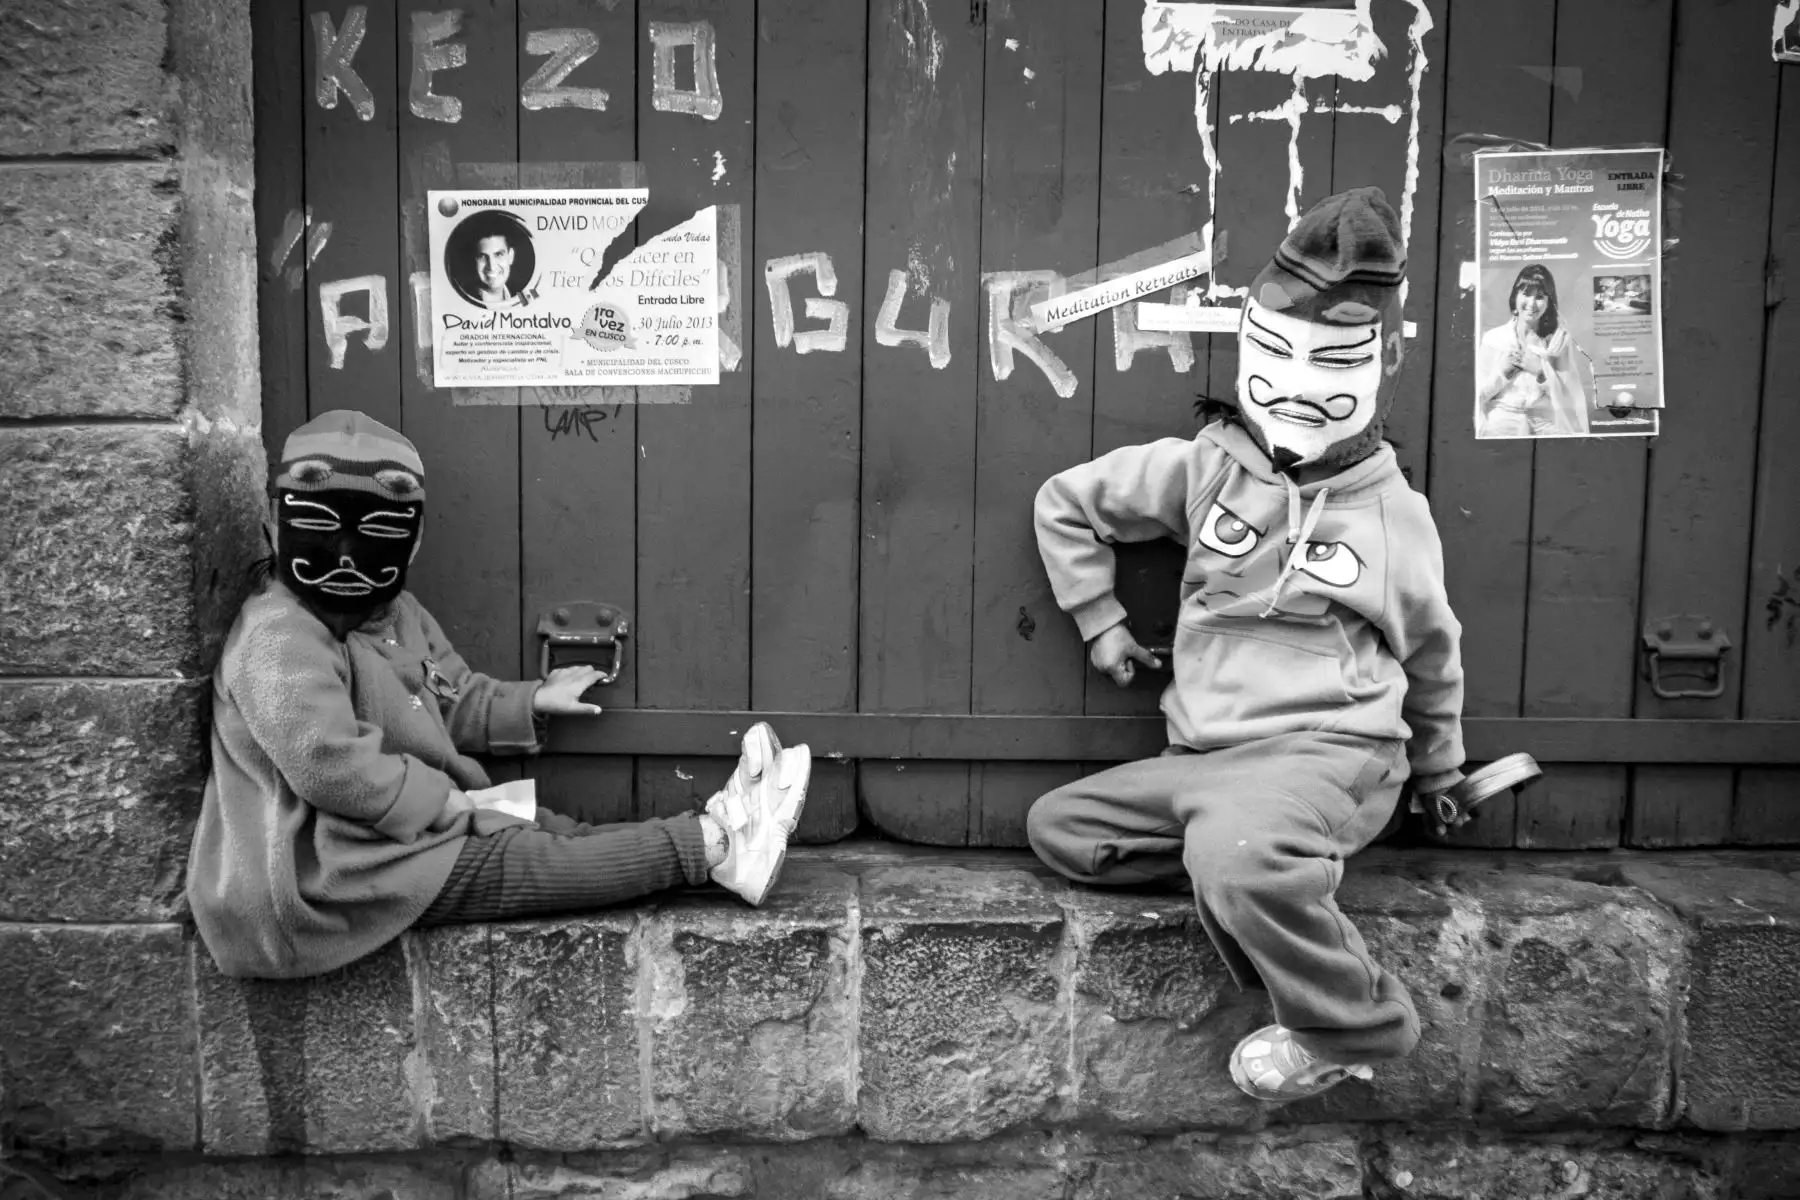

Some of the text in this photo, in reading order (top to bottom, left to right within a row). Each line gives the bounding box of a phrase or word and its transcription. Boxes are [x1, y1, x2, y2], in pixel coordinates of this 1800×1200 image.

[1556, 166, 1593, 184] Yoga
[1608, 172, 1654, 180] ENTRADA
[1488, 184, 1594, 196] Meditación y Mantras
[1617, 183, 1645, 191] LIBRE
[461, 199, 506, 207] HONORABLE
[509, 198, 566, 206] MUNICIPALIDAD
[569, 197, 613, 205] PROVINCIAL
[536, 215, 588, 231] DAVID
[1591, 213, 1650, 243] Yoga
[674, 250, 695, 264] en
[638, 294, 705, 305] Entrada Libre
[1047, 267, 1198, 323] Meditation Retreats
[442, 311, 571, 331] David Montalvo
[594, 307, 615, 321] 1ra
[600, 319, 625, 333] vez
[639, 315, 713, 332] 30 Julio 2013
[585, 328, 626, 342] EN CUSCO
[655, 334, 679, 346] 7:00
[587, 359, 645, 367] MUNICIPALIDAD
[648, 358, 662, 366] DEL
[586, 368, 596, 376] DE
[598, 367, 656, 376] CONVENCIONES
[658, 367, 712, 376] MACHUPICCHU
